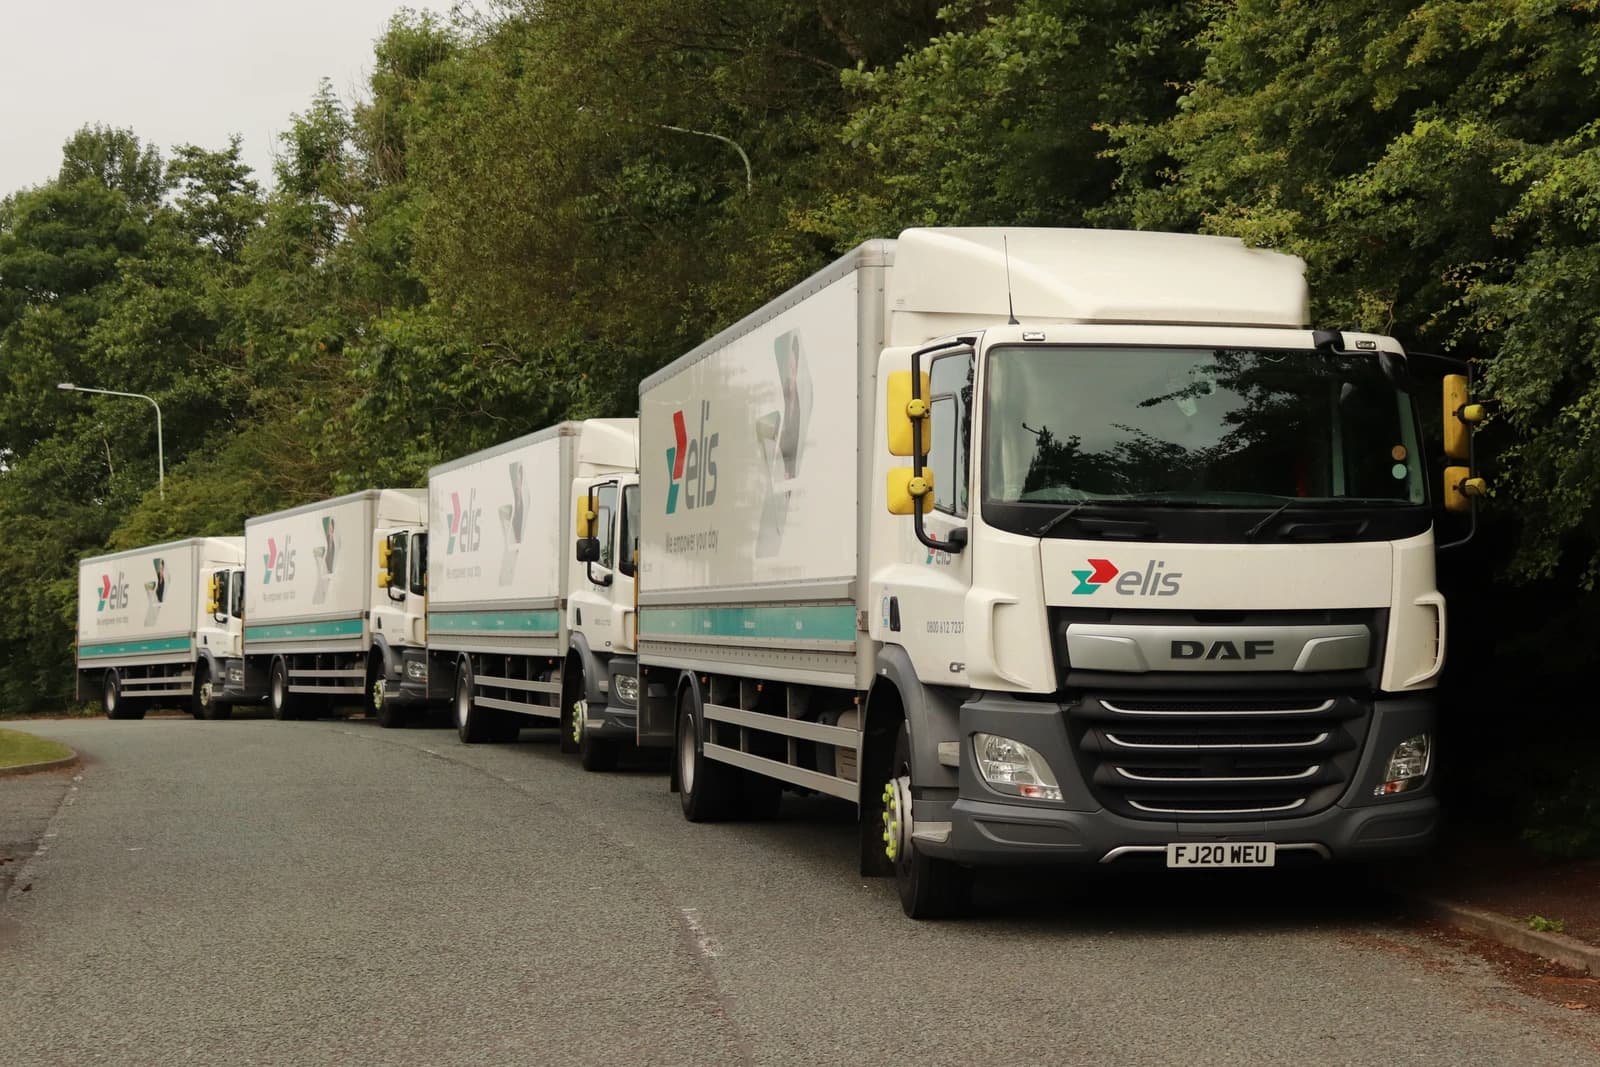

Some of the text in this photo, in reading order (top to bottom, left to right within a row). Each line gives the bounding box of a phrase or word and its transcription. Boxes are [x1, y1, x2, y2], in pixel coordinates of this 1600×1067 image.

[685, 399, 719, 509] elis
[460, 488, 481, 553] elis
[276, 534, 296, 582] elis
[673, 534, 696, 555] empower
[696, 531, 708, 556] your
[109, 571, 129, 609] elis
[1115, 559, 1183, 596] elis
[949, 662, 965, 673] CF
[1170, 640, 1274, 660] DAF
[1174, 845, 1267, 865] FJ20 WEU
